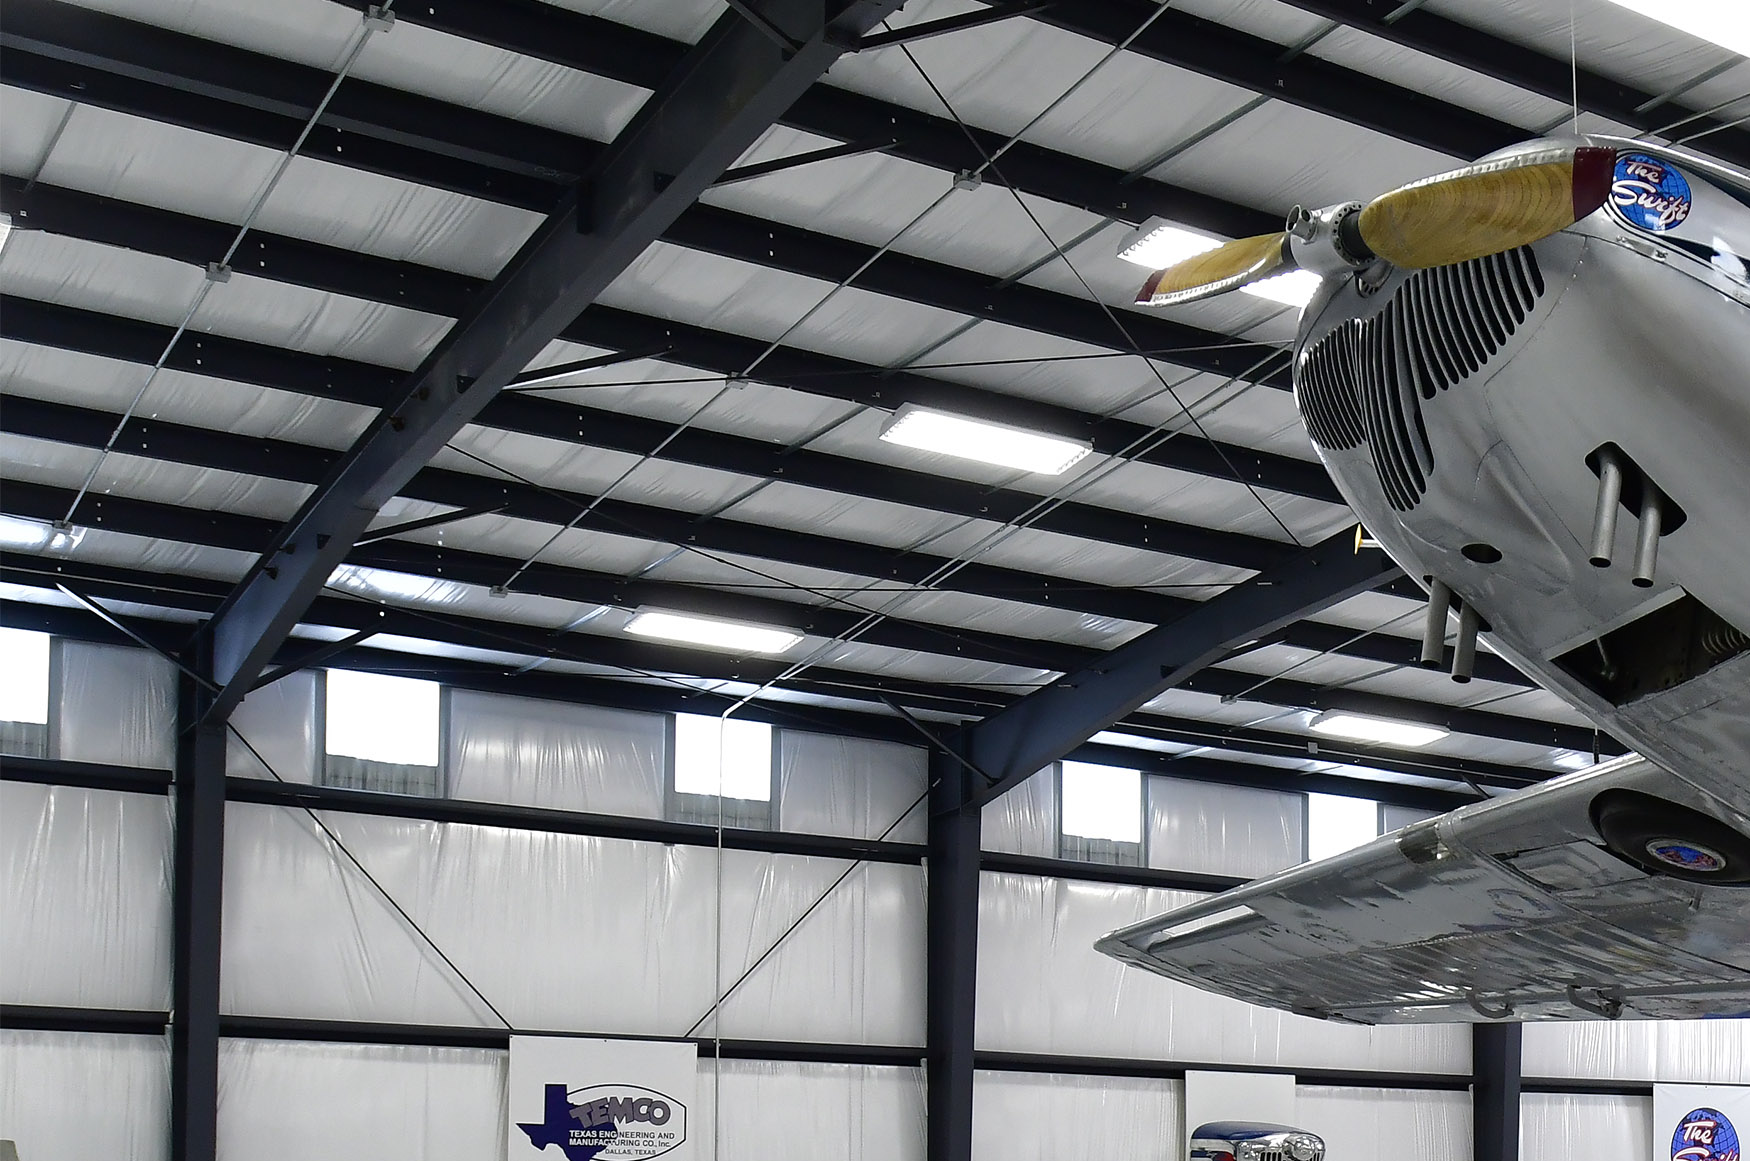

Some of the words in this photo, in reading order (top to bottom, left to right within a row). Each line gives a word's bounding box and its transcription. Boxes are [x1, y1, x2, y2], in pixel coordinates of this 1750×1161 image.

[1626, 160, 1663, 183] The
[1612, 180, 1689, 226] Swift
[569, 1097, 671, 1128] TEMCO
[569, 1130, 597, 1138] TEXAS
[600, 1130, 655, 1139] ENGINEERING
[657, 1132, 675, 1140] AND
[569, 1138, 641, 1147] MANUFACTURING
[1683, 1120, 1717, 1145] The
